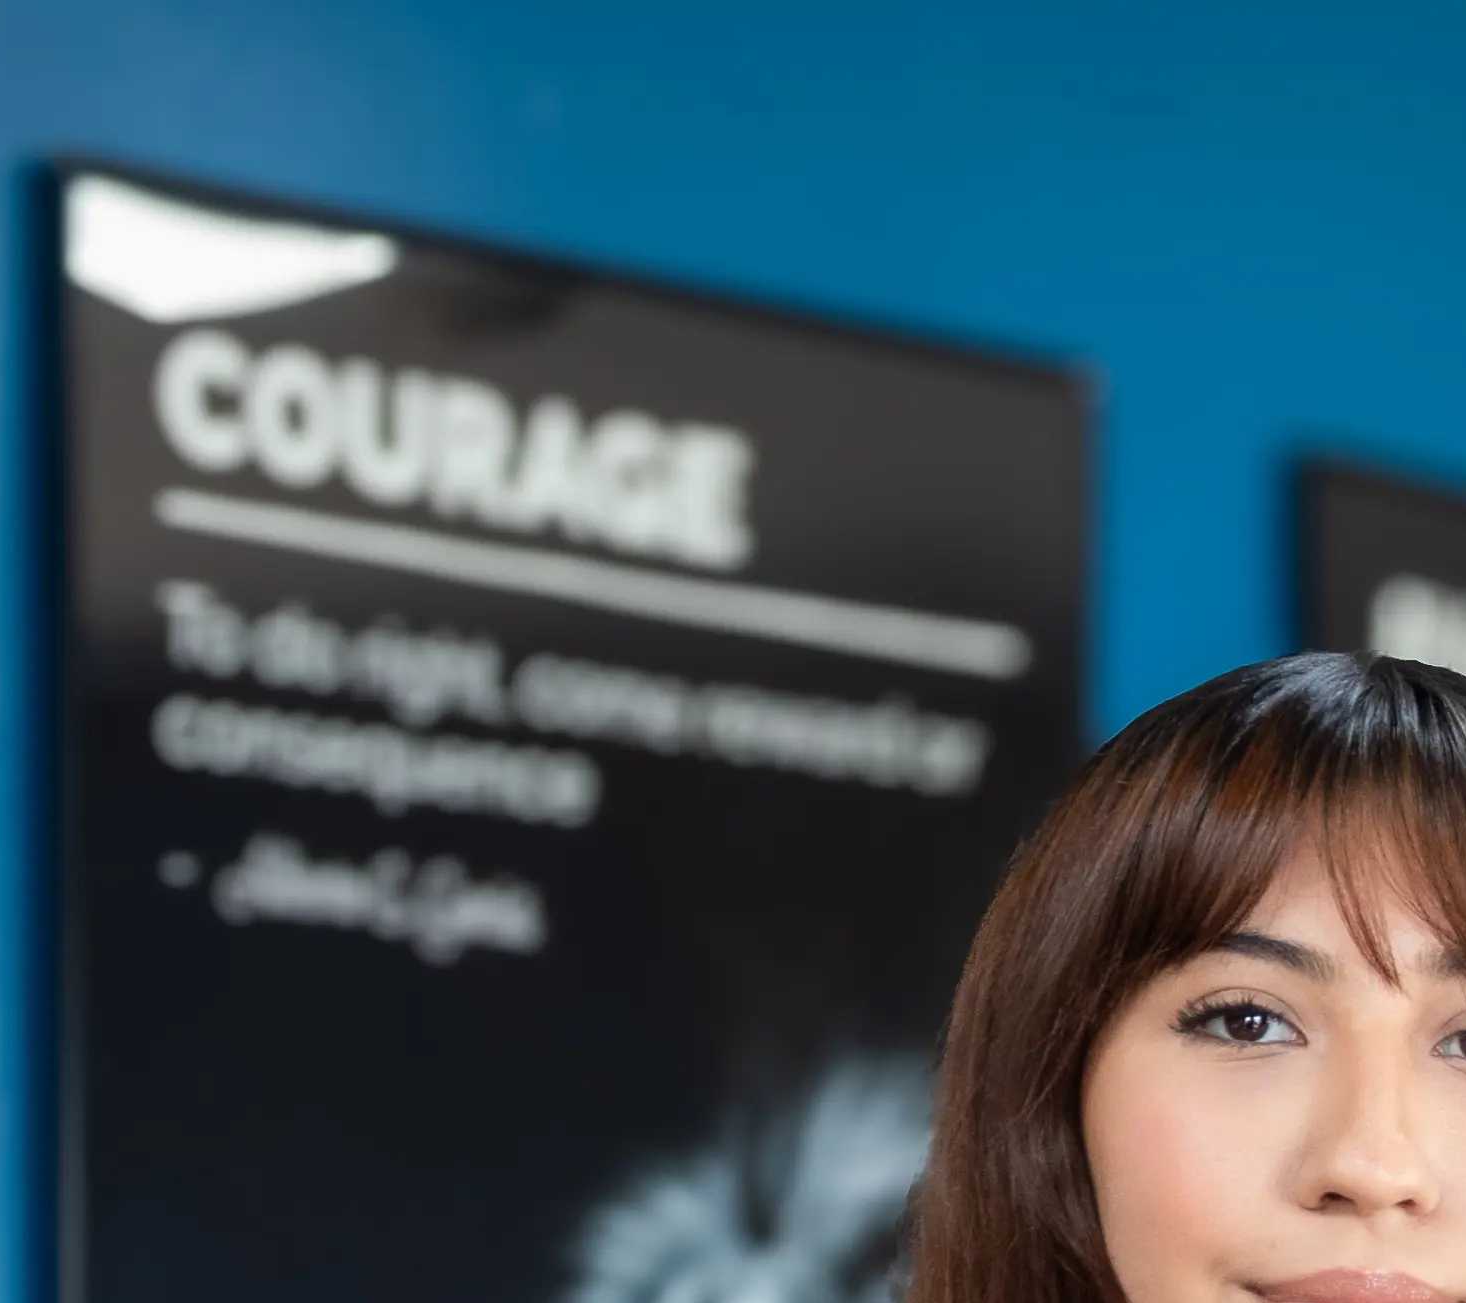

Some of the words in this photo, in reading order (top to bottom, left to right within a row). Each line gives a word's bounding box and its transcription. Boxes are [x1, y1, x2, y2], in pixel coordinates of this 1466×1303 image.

[158, 330, 750, 567] COURAGE
[156, 580, 242, 678] To
[151, 693, 600, 828] consequence
